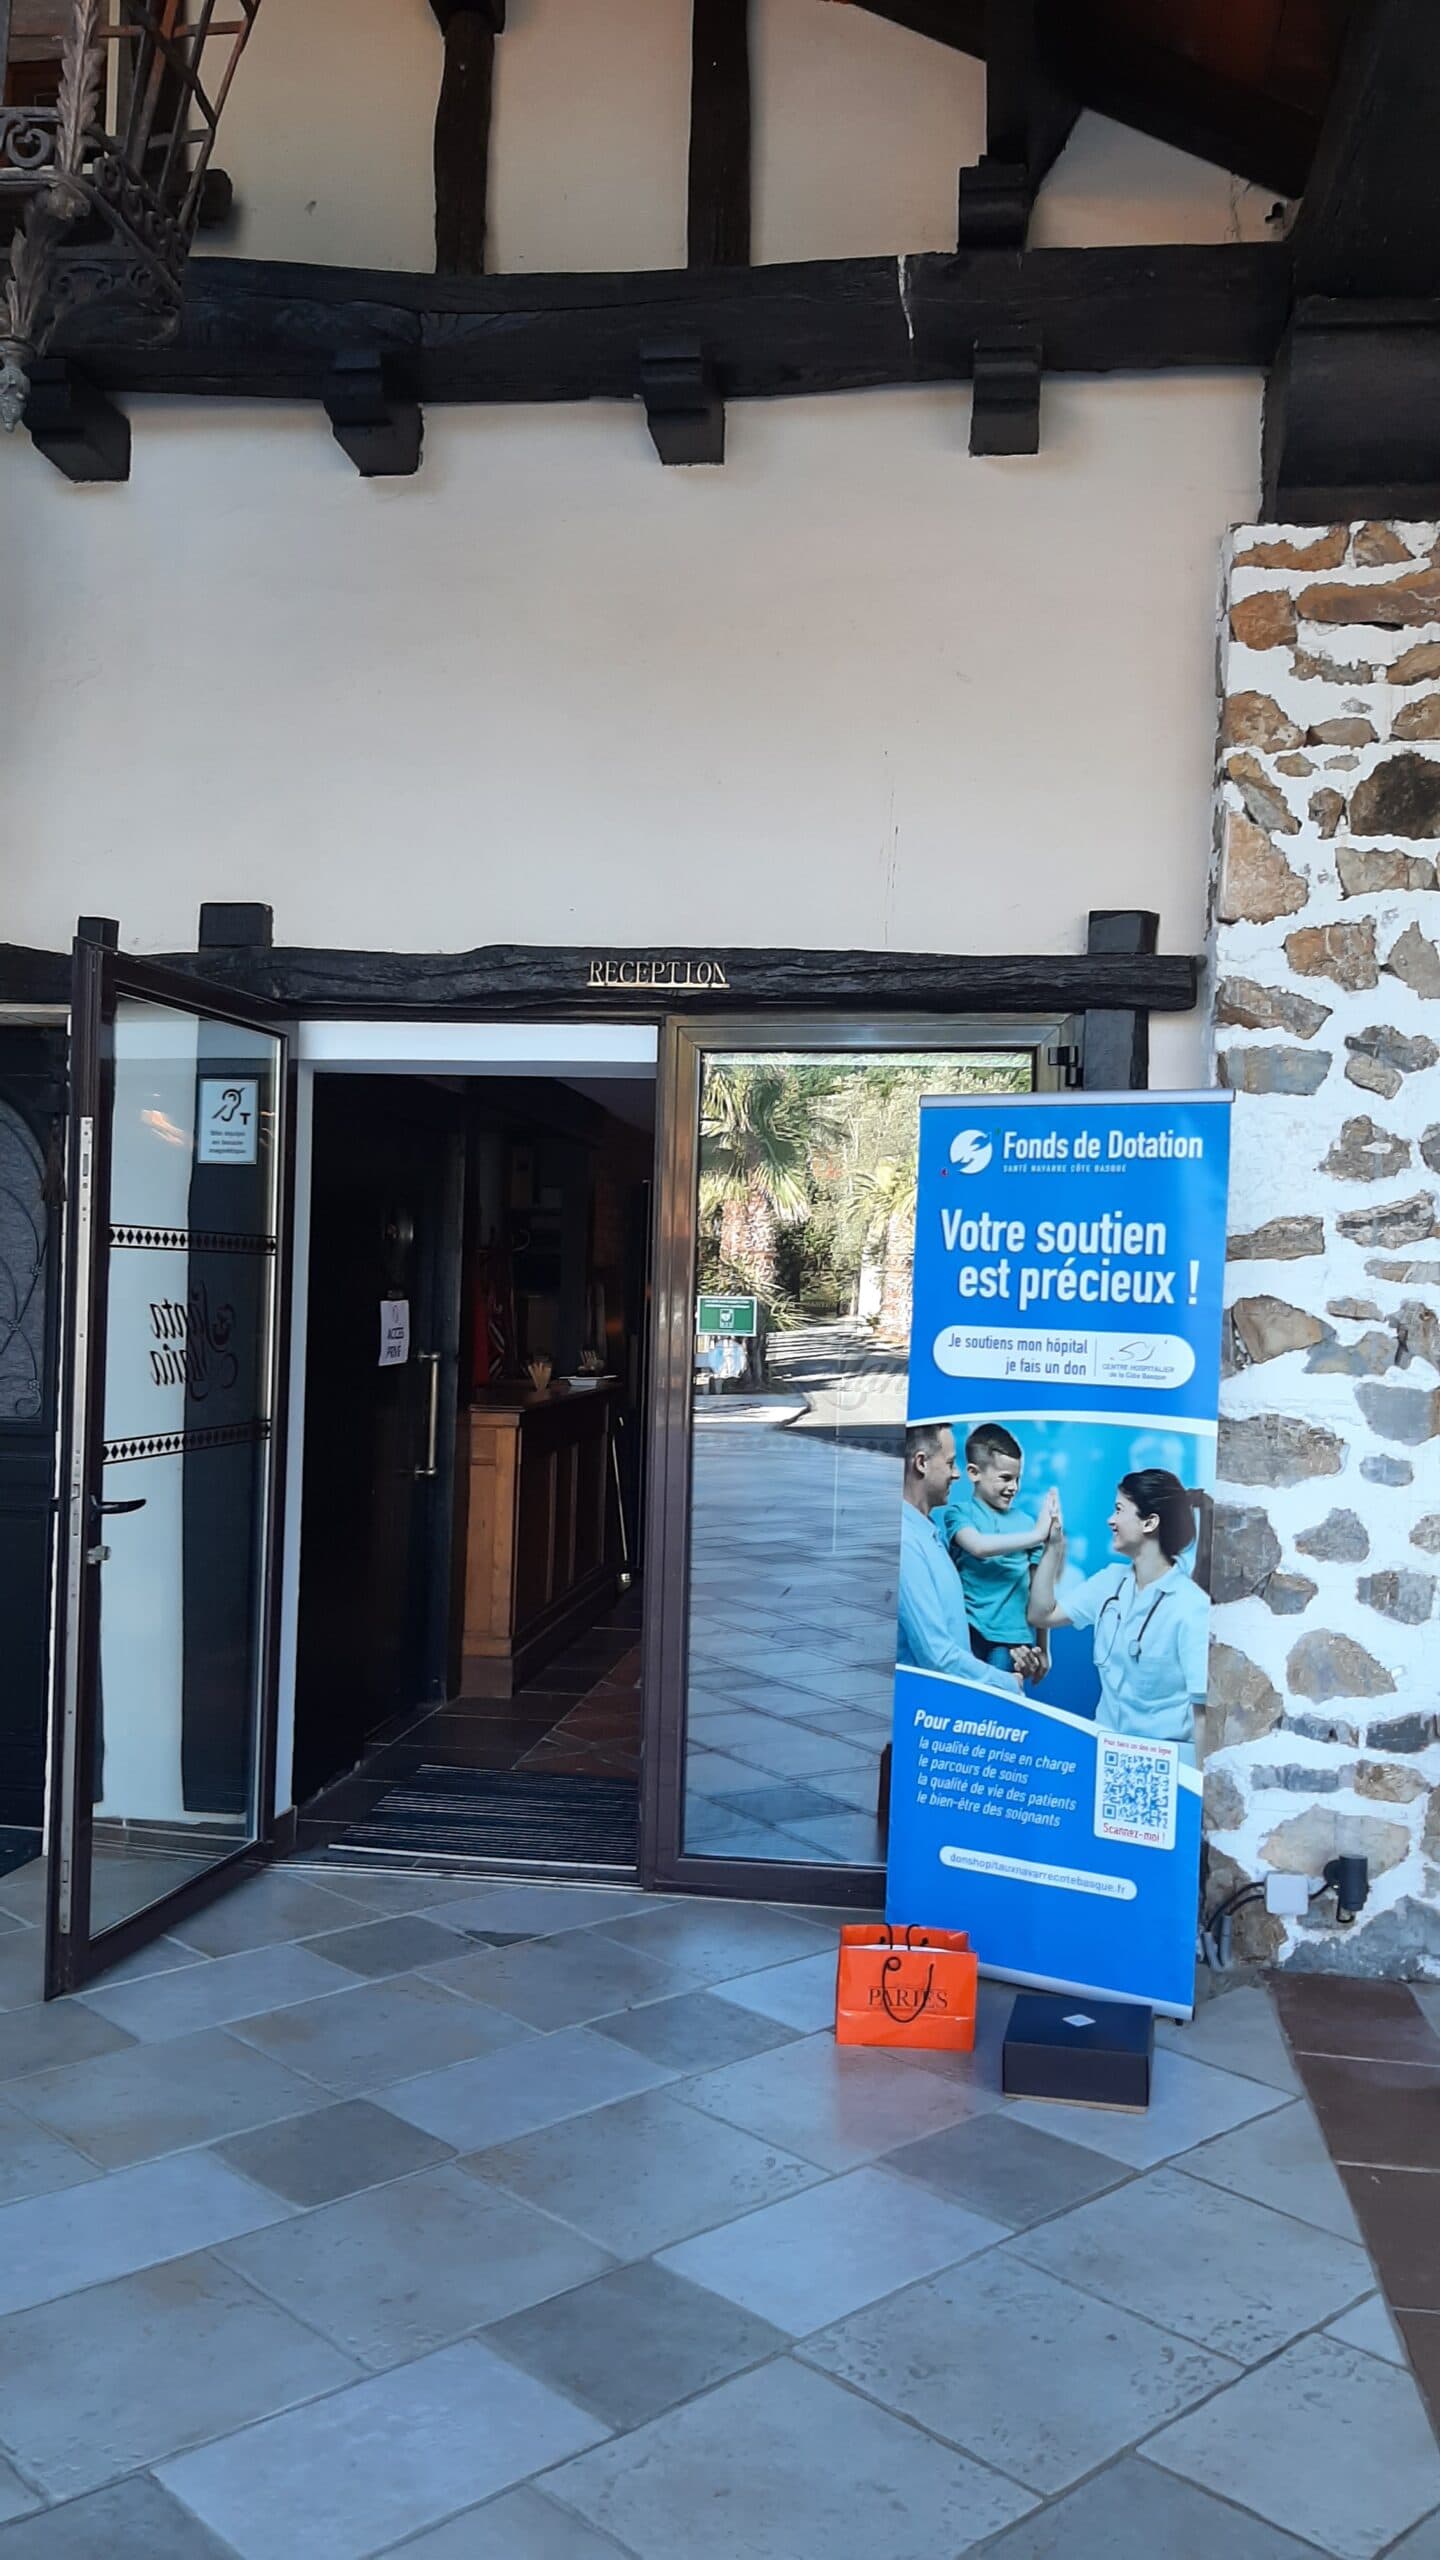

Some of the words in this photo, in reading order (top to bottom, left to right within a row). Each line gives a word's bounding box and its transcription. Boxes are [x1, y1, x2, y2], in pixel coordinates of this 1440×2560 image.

[588, 959, 728, 985] RECEPTION
[1003, 1130, 1069, 1160] Fonds
[1073, 1130, 1101, 1160] de
[1107, 1129, 1204, 1160] Dotation
[940, 1207, 1026, 1253] Votre
[1035, 1210, 1168, 1256] soutien
[958, 1257, 1012, 1299] est
[1018, 1256, 1177, 1312] précieux
[1187, 1259, 1201, 1306] !
[948, 1332, 962, 1349] Je
[964, 1335, 1014, 1352] soutiens
[1016, 1338, 1043, 1353] mon
[1046, 1337, 1089, 1357] hôpital
[1004, 1357, 1017, 1376] je
[1019, 1358, 1042, 1374] fais
[1044, 1362, 1060, 1375] un
[1063, 1359, 1088, 1377] don
[913, 1708, 951, 1732] Pour
[952, 1718, 1029, 1744] améliorer
[918, 1754, 929, 1768] le
[930, 1757, 981, 1776] parcours
[982, 1763, 998, 1779] de
[998, 1768, 1029, 1785] soins
[919, 1736, 929, 1750] la
[931, 1740, 970, 1756] qualité
[971, 1744, 987, 1759] de
[987, 1748, 1017, 1764] prise
[1018, 1754, 1033, 1767] en
[1035, 1755, 1077, 1775] charge
[917, 1772, 928, 1786] la
[930, 1776, 969, 1793] qualité
[970, 1781, 985, 1796] de
[987, 1783, 1004, 1798] vie
[1006, 1786, 1026, 1803] des
[1027, 1793, 1078, 1812] patients
[916, 1790, 929, 1805] le
[929, 1794, 981, 1813] bien-être
[982, 1801, 1003, 1818] des
[1005, 1807, 1062, 1828] soignants
[1102, 1822, 1160, 1843] Scannez-moi
